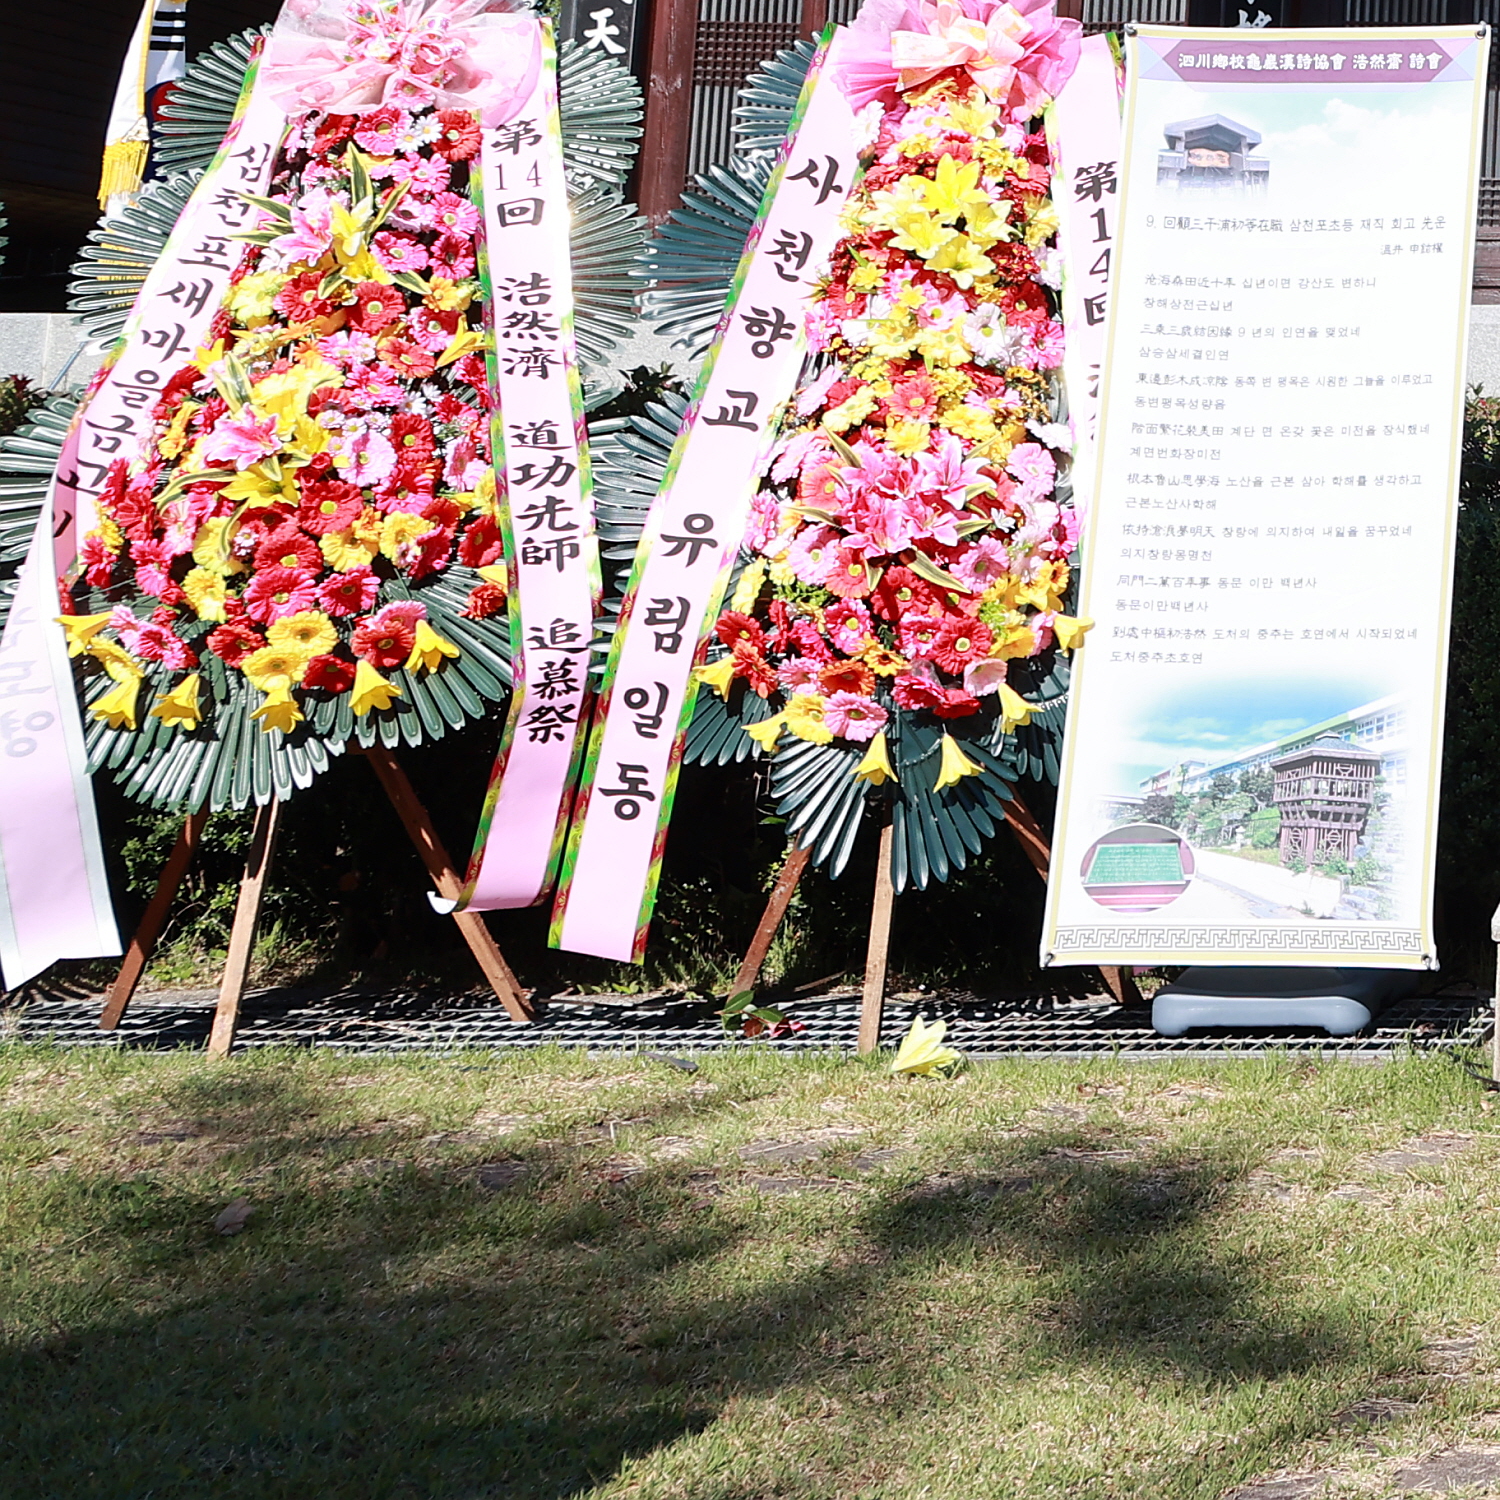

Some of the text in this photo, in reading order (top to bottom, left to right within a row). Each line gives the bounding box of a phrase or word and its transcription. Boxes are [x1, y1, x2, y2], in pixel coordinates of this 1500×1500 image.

[1409, 52, 1444, 70] 詩會
[599, 154, 843, 821] 사천향교 유림일동
[525, 619, 590, 743] 追慕祭
